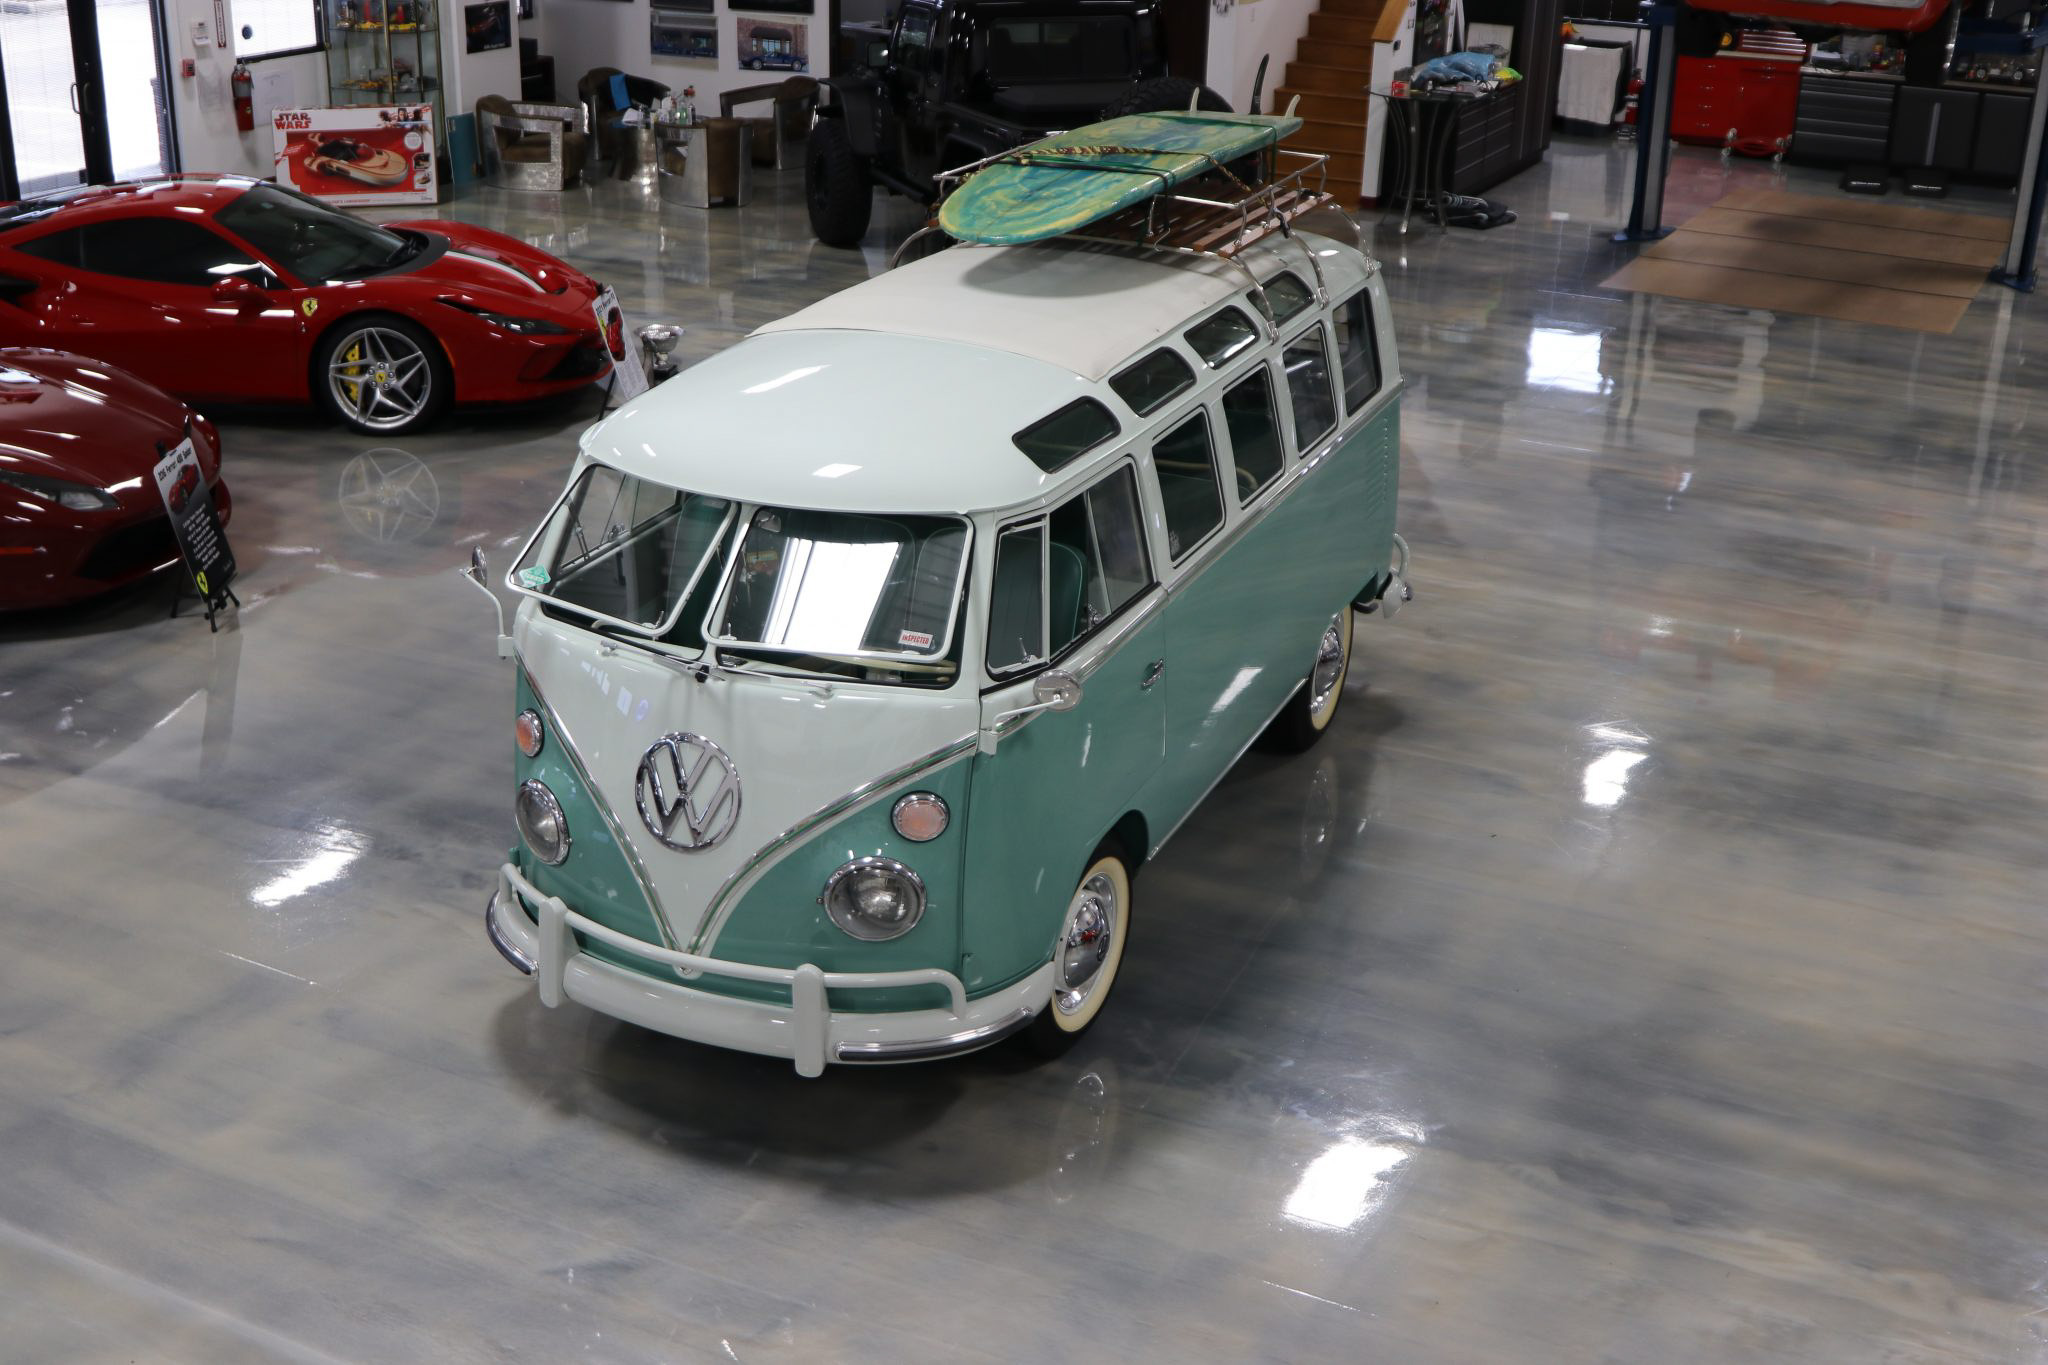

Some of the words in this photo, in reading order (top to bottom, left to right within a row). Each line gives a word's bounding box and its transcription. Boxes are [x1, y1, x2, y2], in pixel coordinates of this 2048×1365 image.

[274, 112, 311, 121] STAR
[274, 119, 311, 130] WARS
[635, 731, 742, 850] VW
